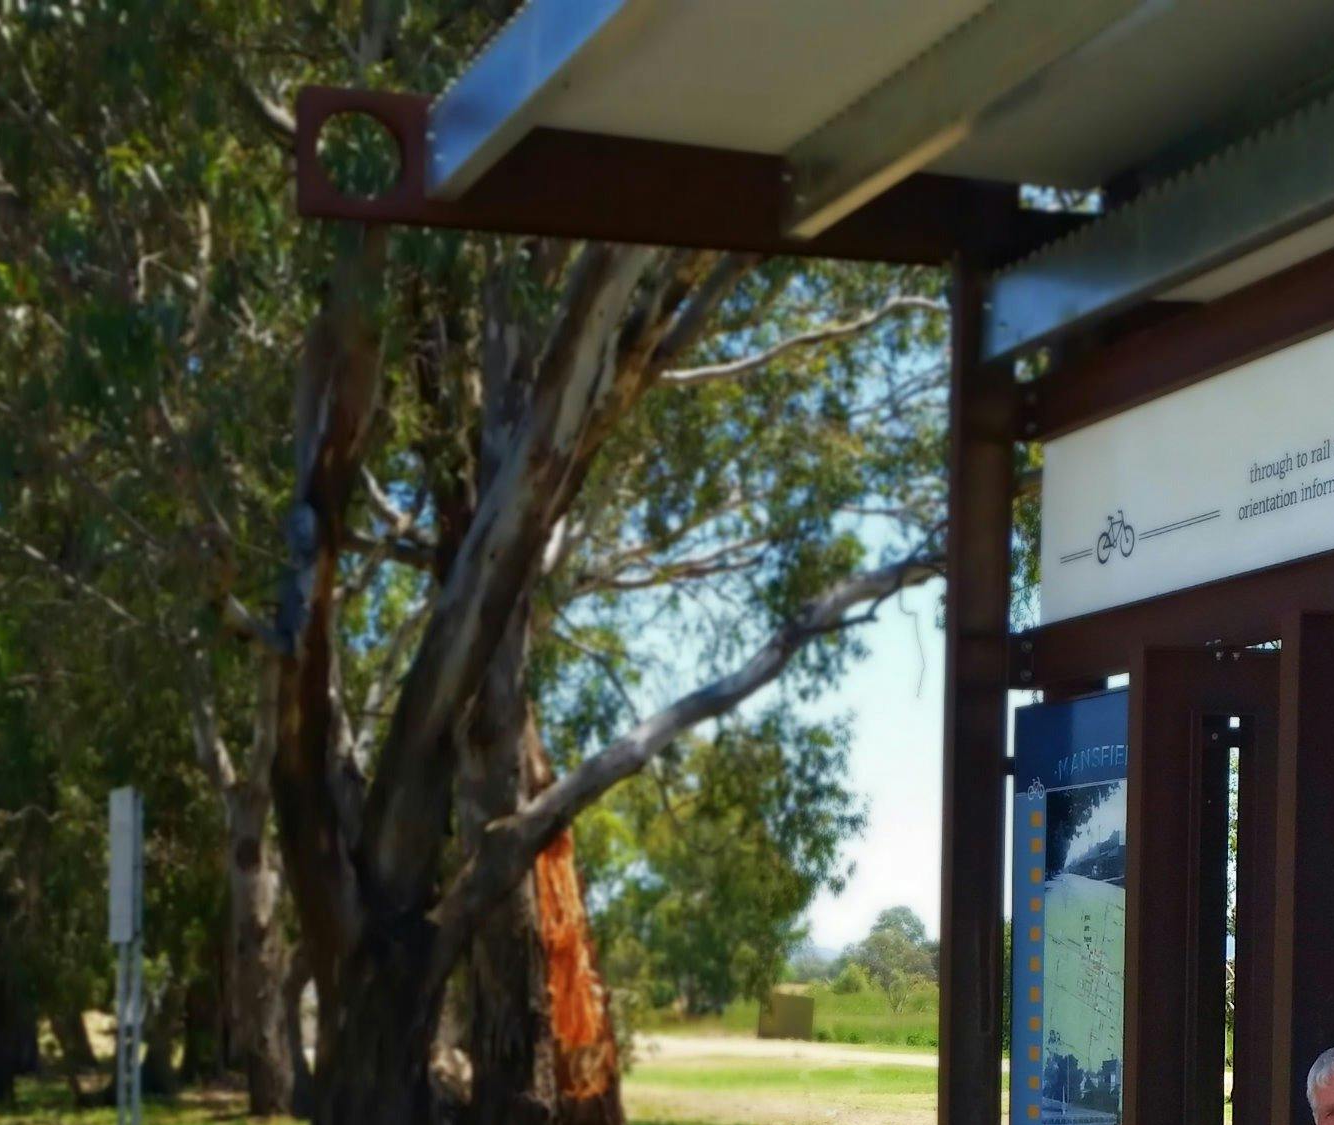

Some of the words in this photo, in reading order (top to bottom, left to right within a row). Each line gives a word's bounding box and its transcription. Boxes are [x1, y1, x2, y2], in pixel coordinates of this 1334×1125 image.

[1250, 452, 1293, 484] through
[1297, 452, 1308, 468] to
[1311, 439, 1330, 464] rail
[1238, 490, 1297, 520] orientation
